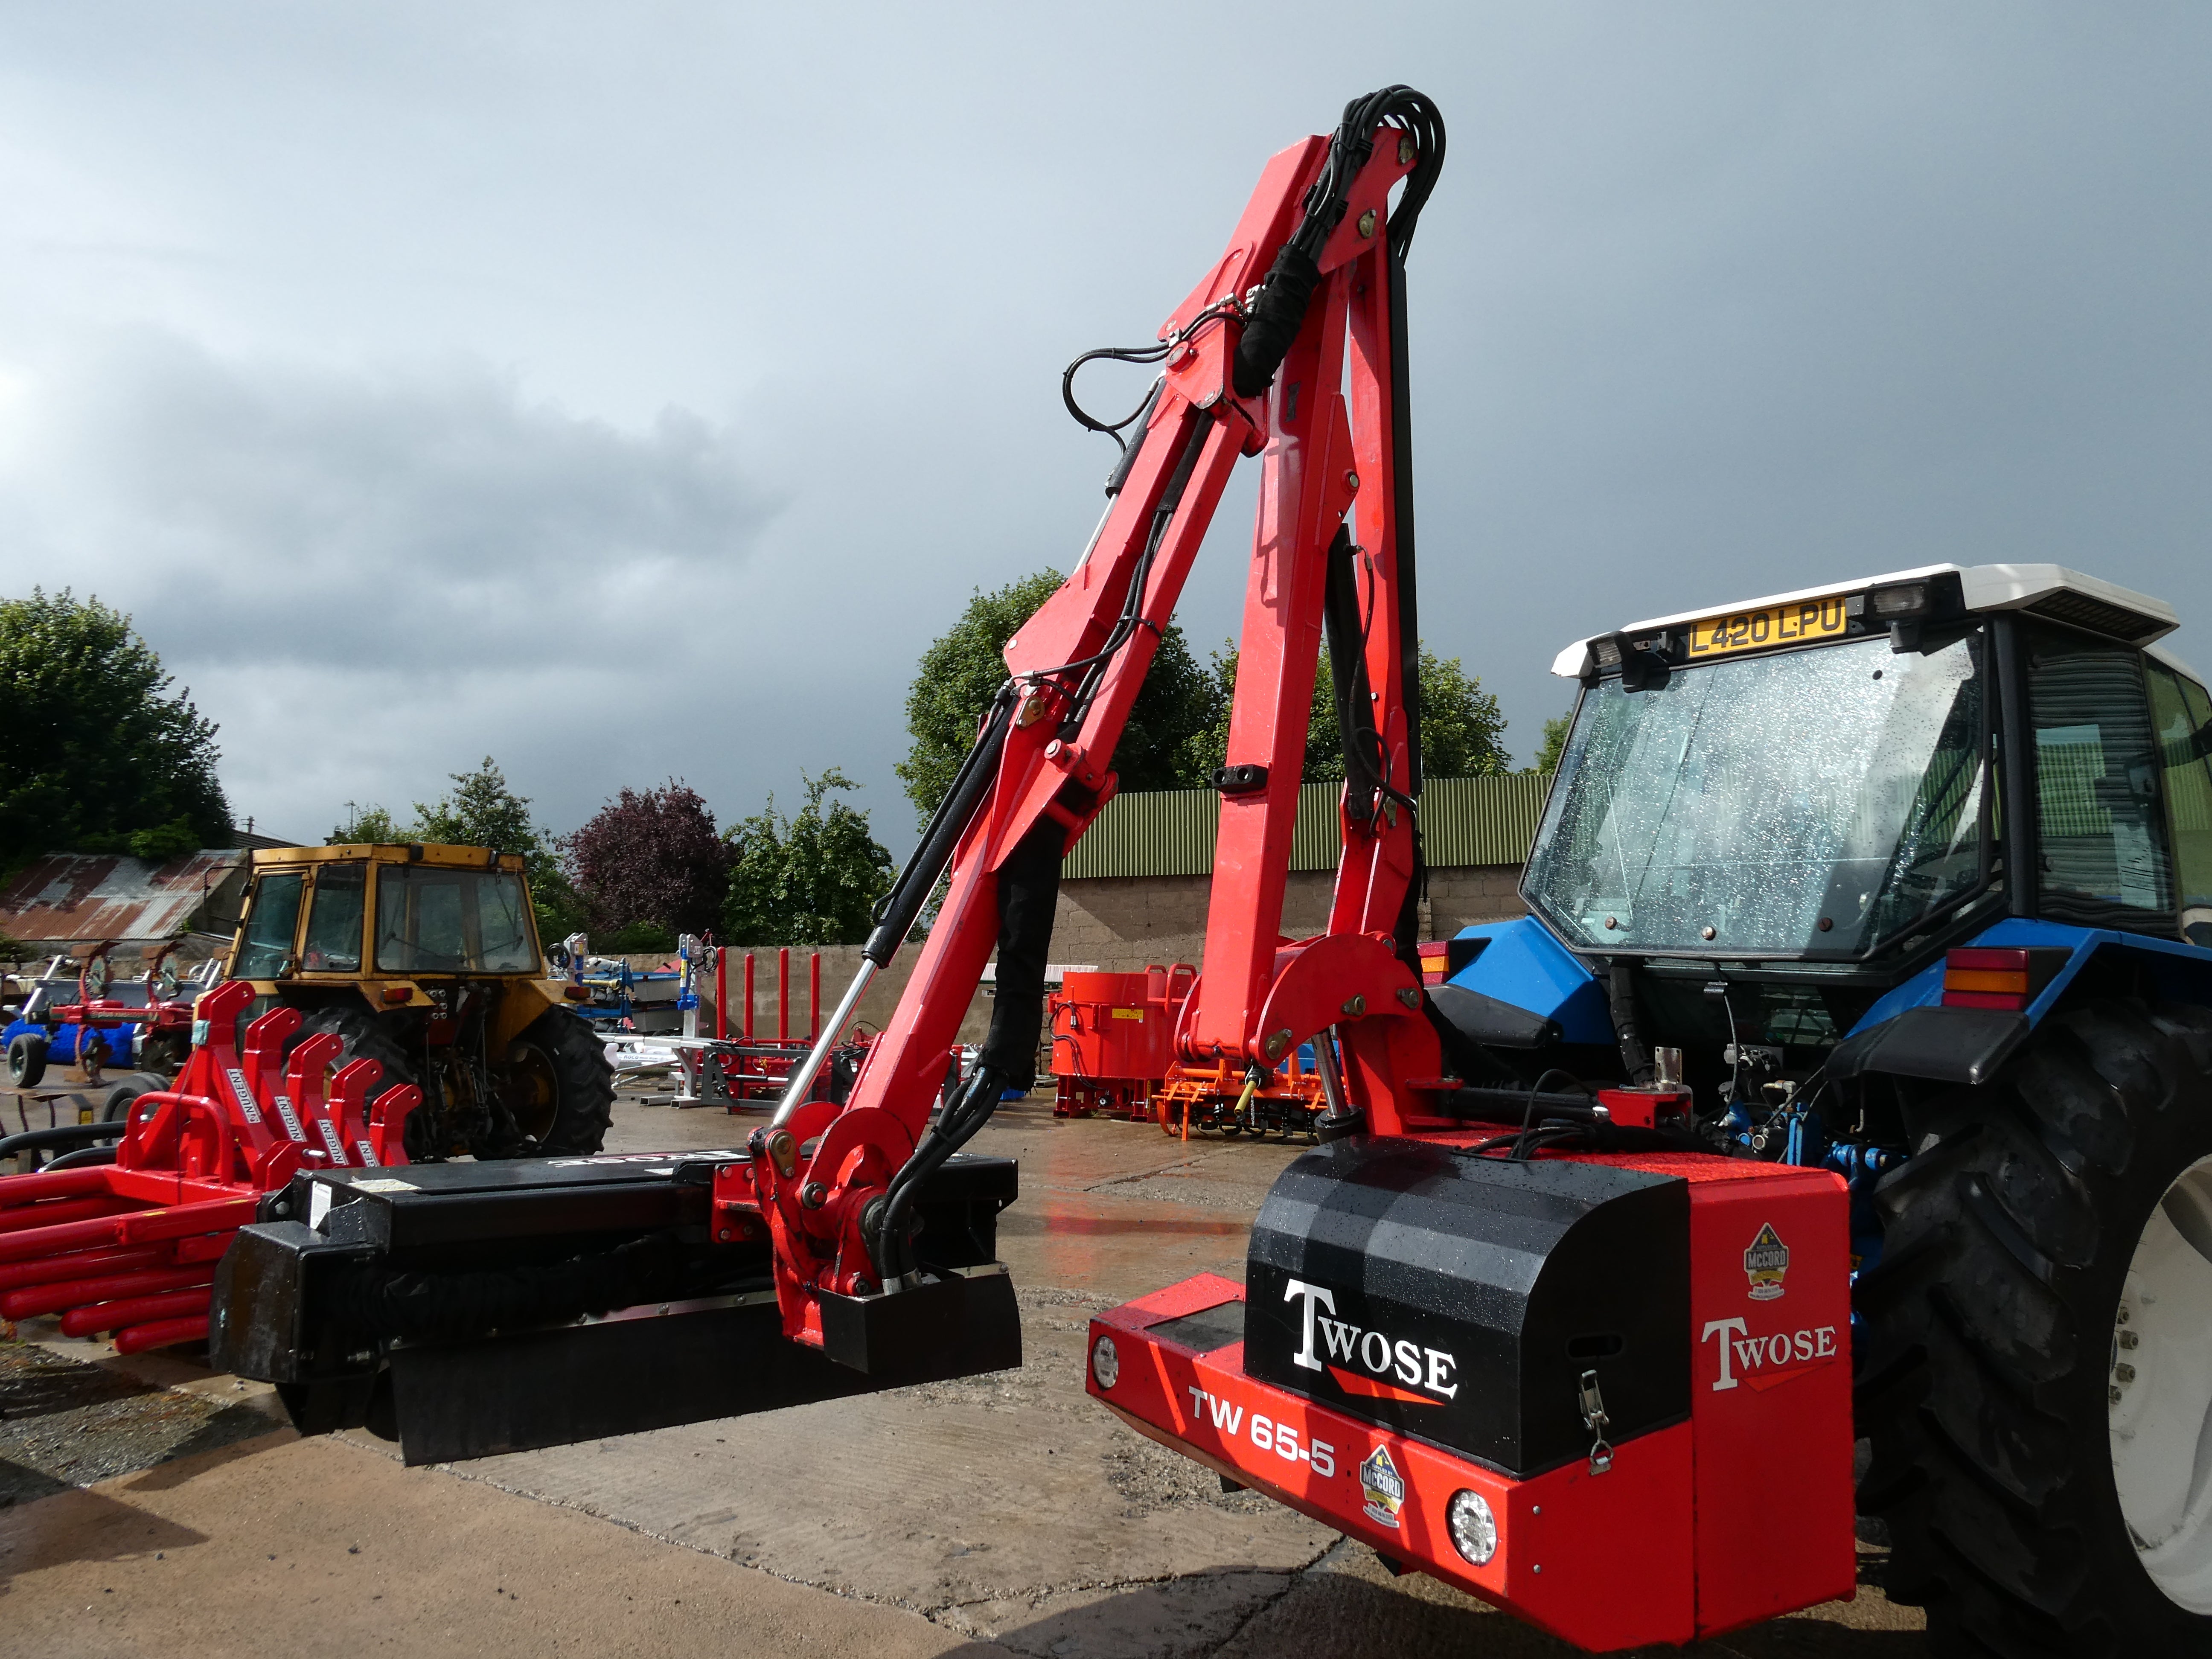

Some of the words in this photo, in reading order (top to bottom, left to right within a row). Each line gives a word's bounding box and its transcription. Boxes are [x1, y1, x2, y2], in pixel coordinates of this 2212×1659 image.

[1691, 613, 1770, 652] L420
[1778, 600, 1842, 639] LPU
[230, 1069, 255, 1113] NUGENT
[277, 1097, 301, 1139] NUGENT
[321, 1121, 343, 1162] NUGENT
[360, 1142, 375, 1167] GENT
[1189, 1385, 1243, 1435] TW
[1251, 1414, 1335, 1478] 65-5
